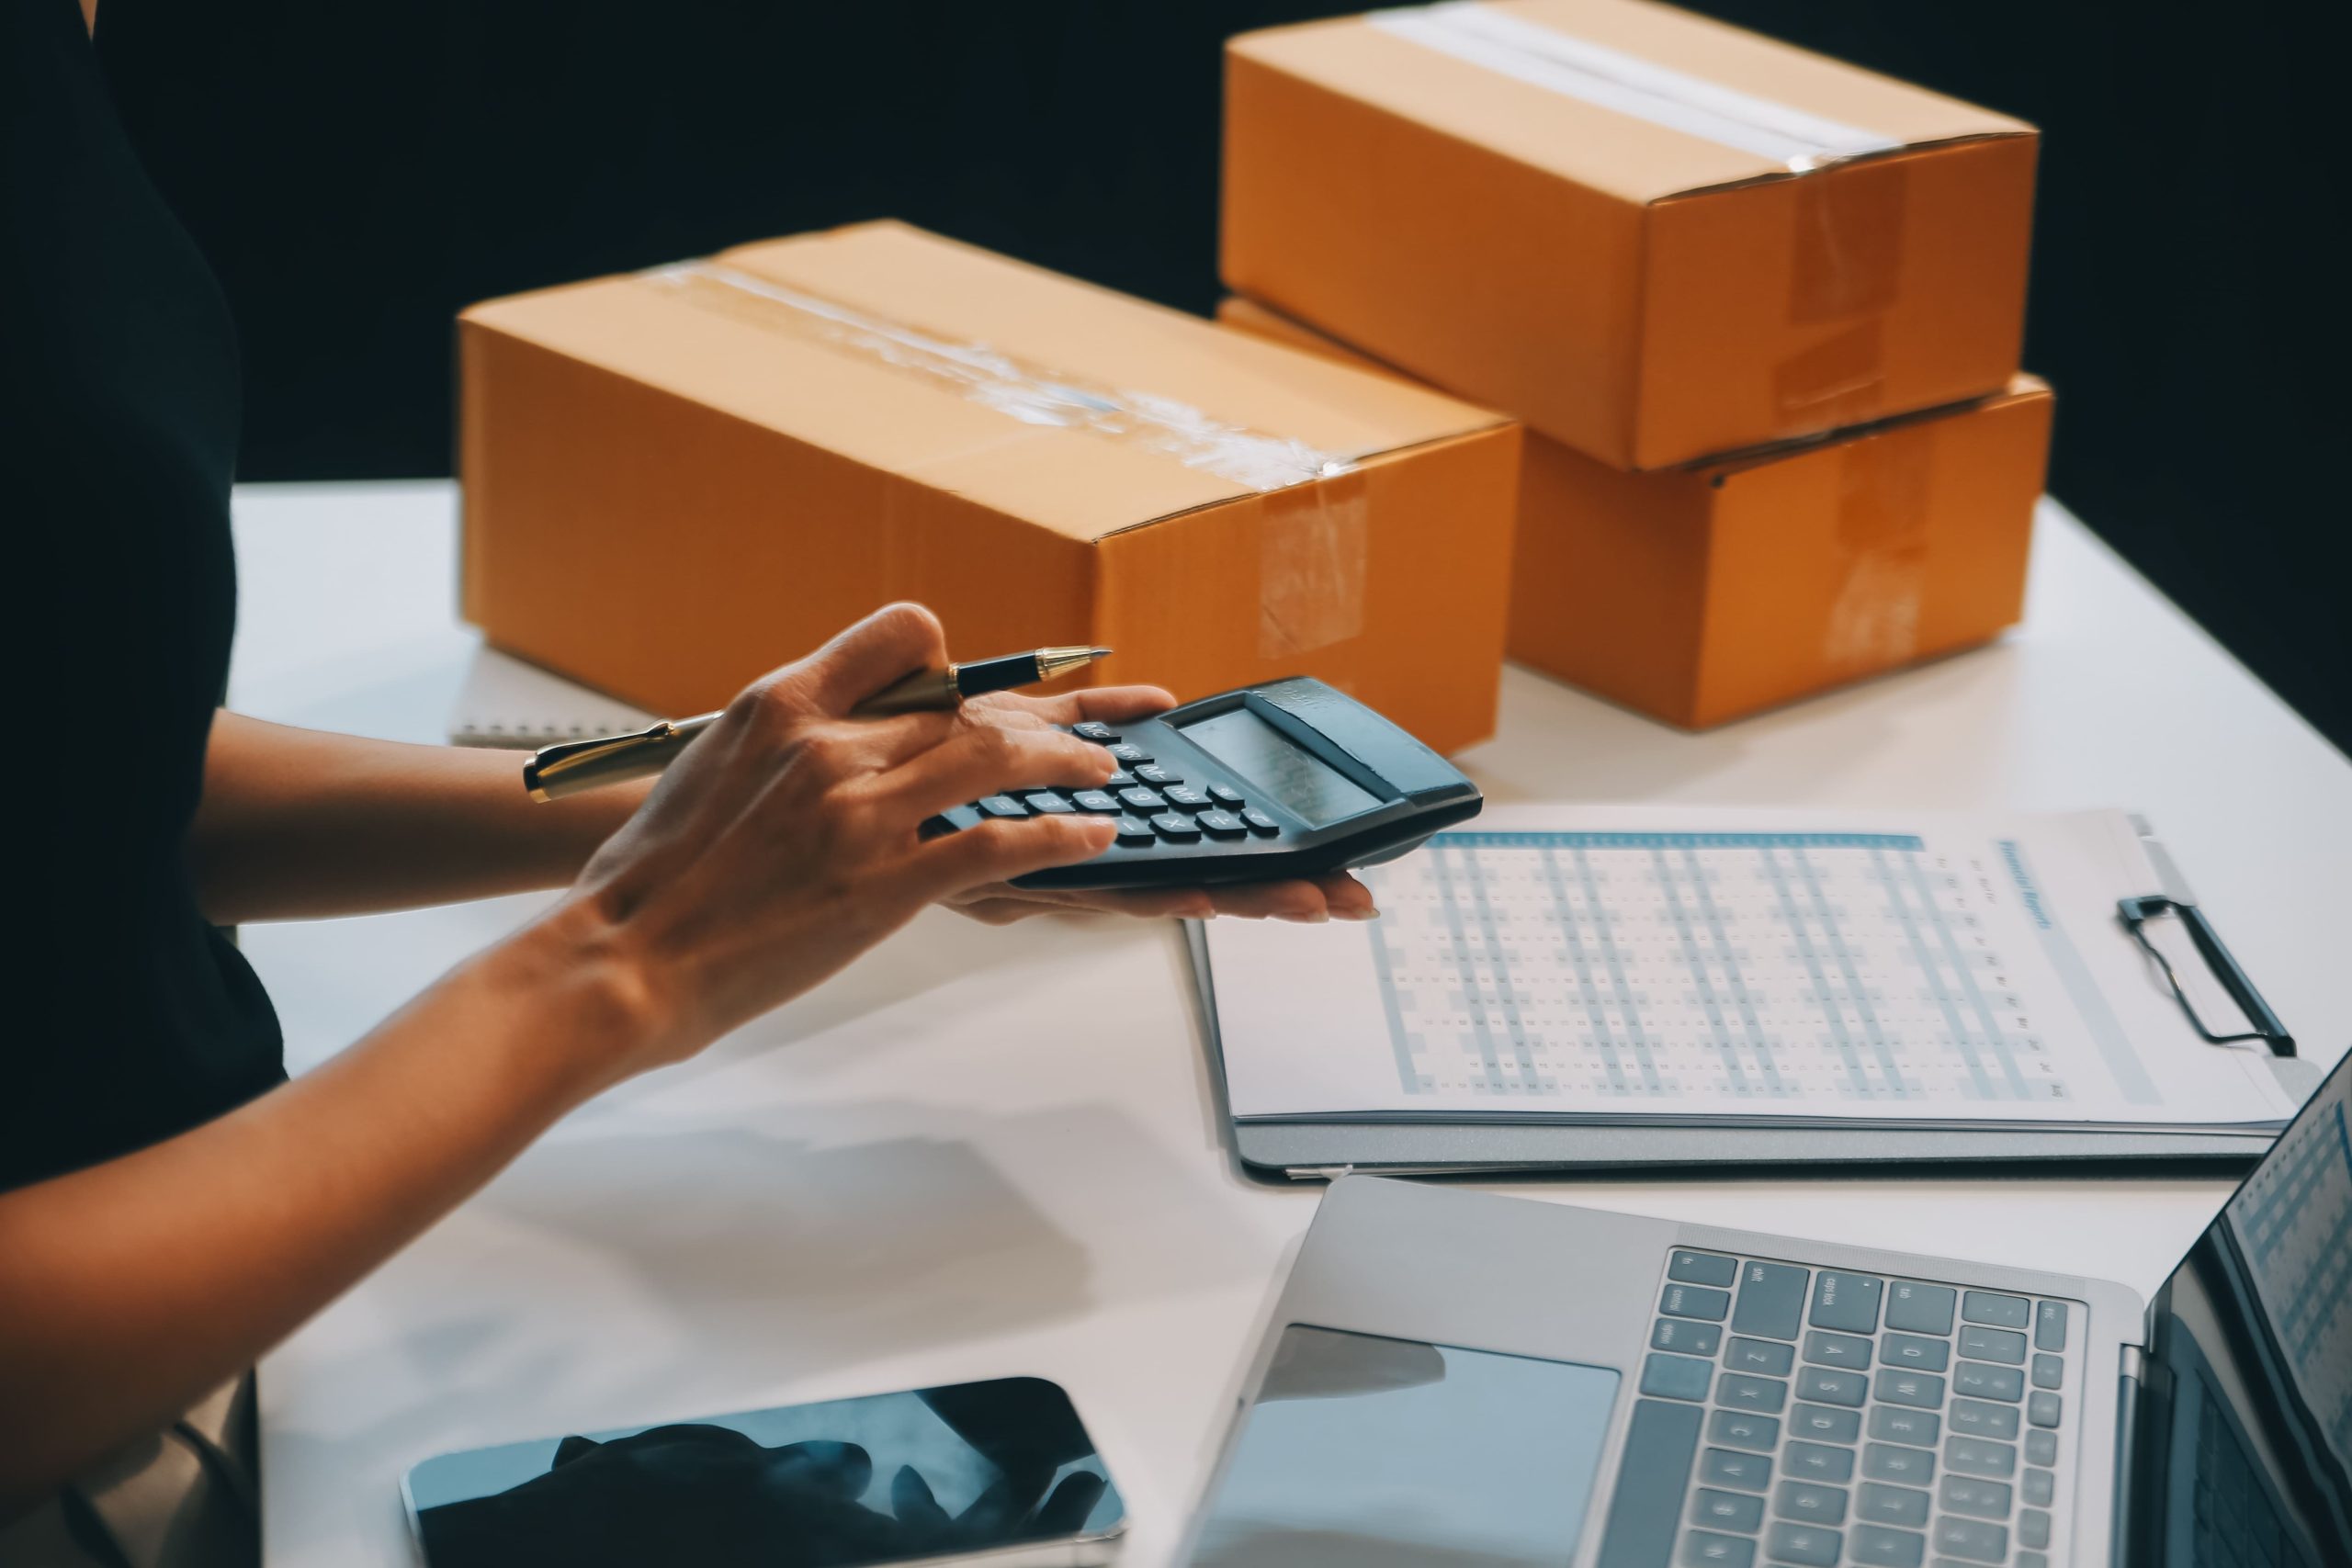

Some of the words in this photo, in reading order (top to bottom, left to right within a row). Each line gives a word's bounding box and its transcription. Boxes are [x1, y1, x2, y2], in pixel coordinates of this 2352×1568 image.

[1080, 724, 1110, 737] MC
[1114, 745, 1141, 759] MR
[1128, 793, 1151, 801] 9
[1998, 840, 2034, 890] Financial
[2021, 891, 2052, 930] Reports
[1751, 1267, 1765, 1282] shift
[1824, 1277, 1836, 1293] caps
[1669, 1289, 1683, 1312] control
[1899, 1288, 1912, 1300] tab
[1660, 1323, 1675, 1345] option
